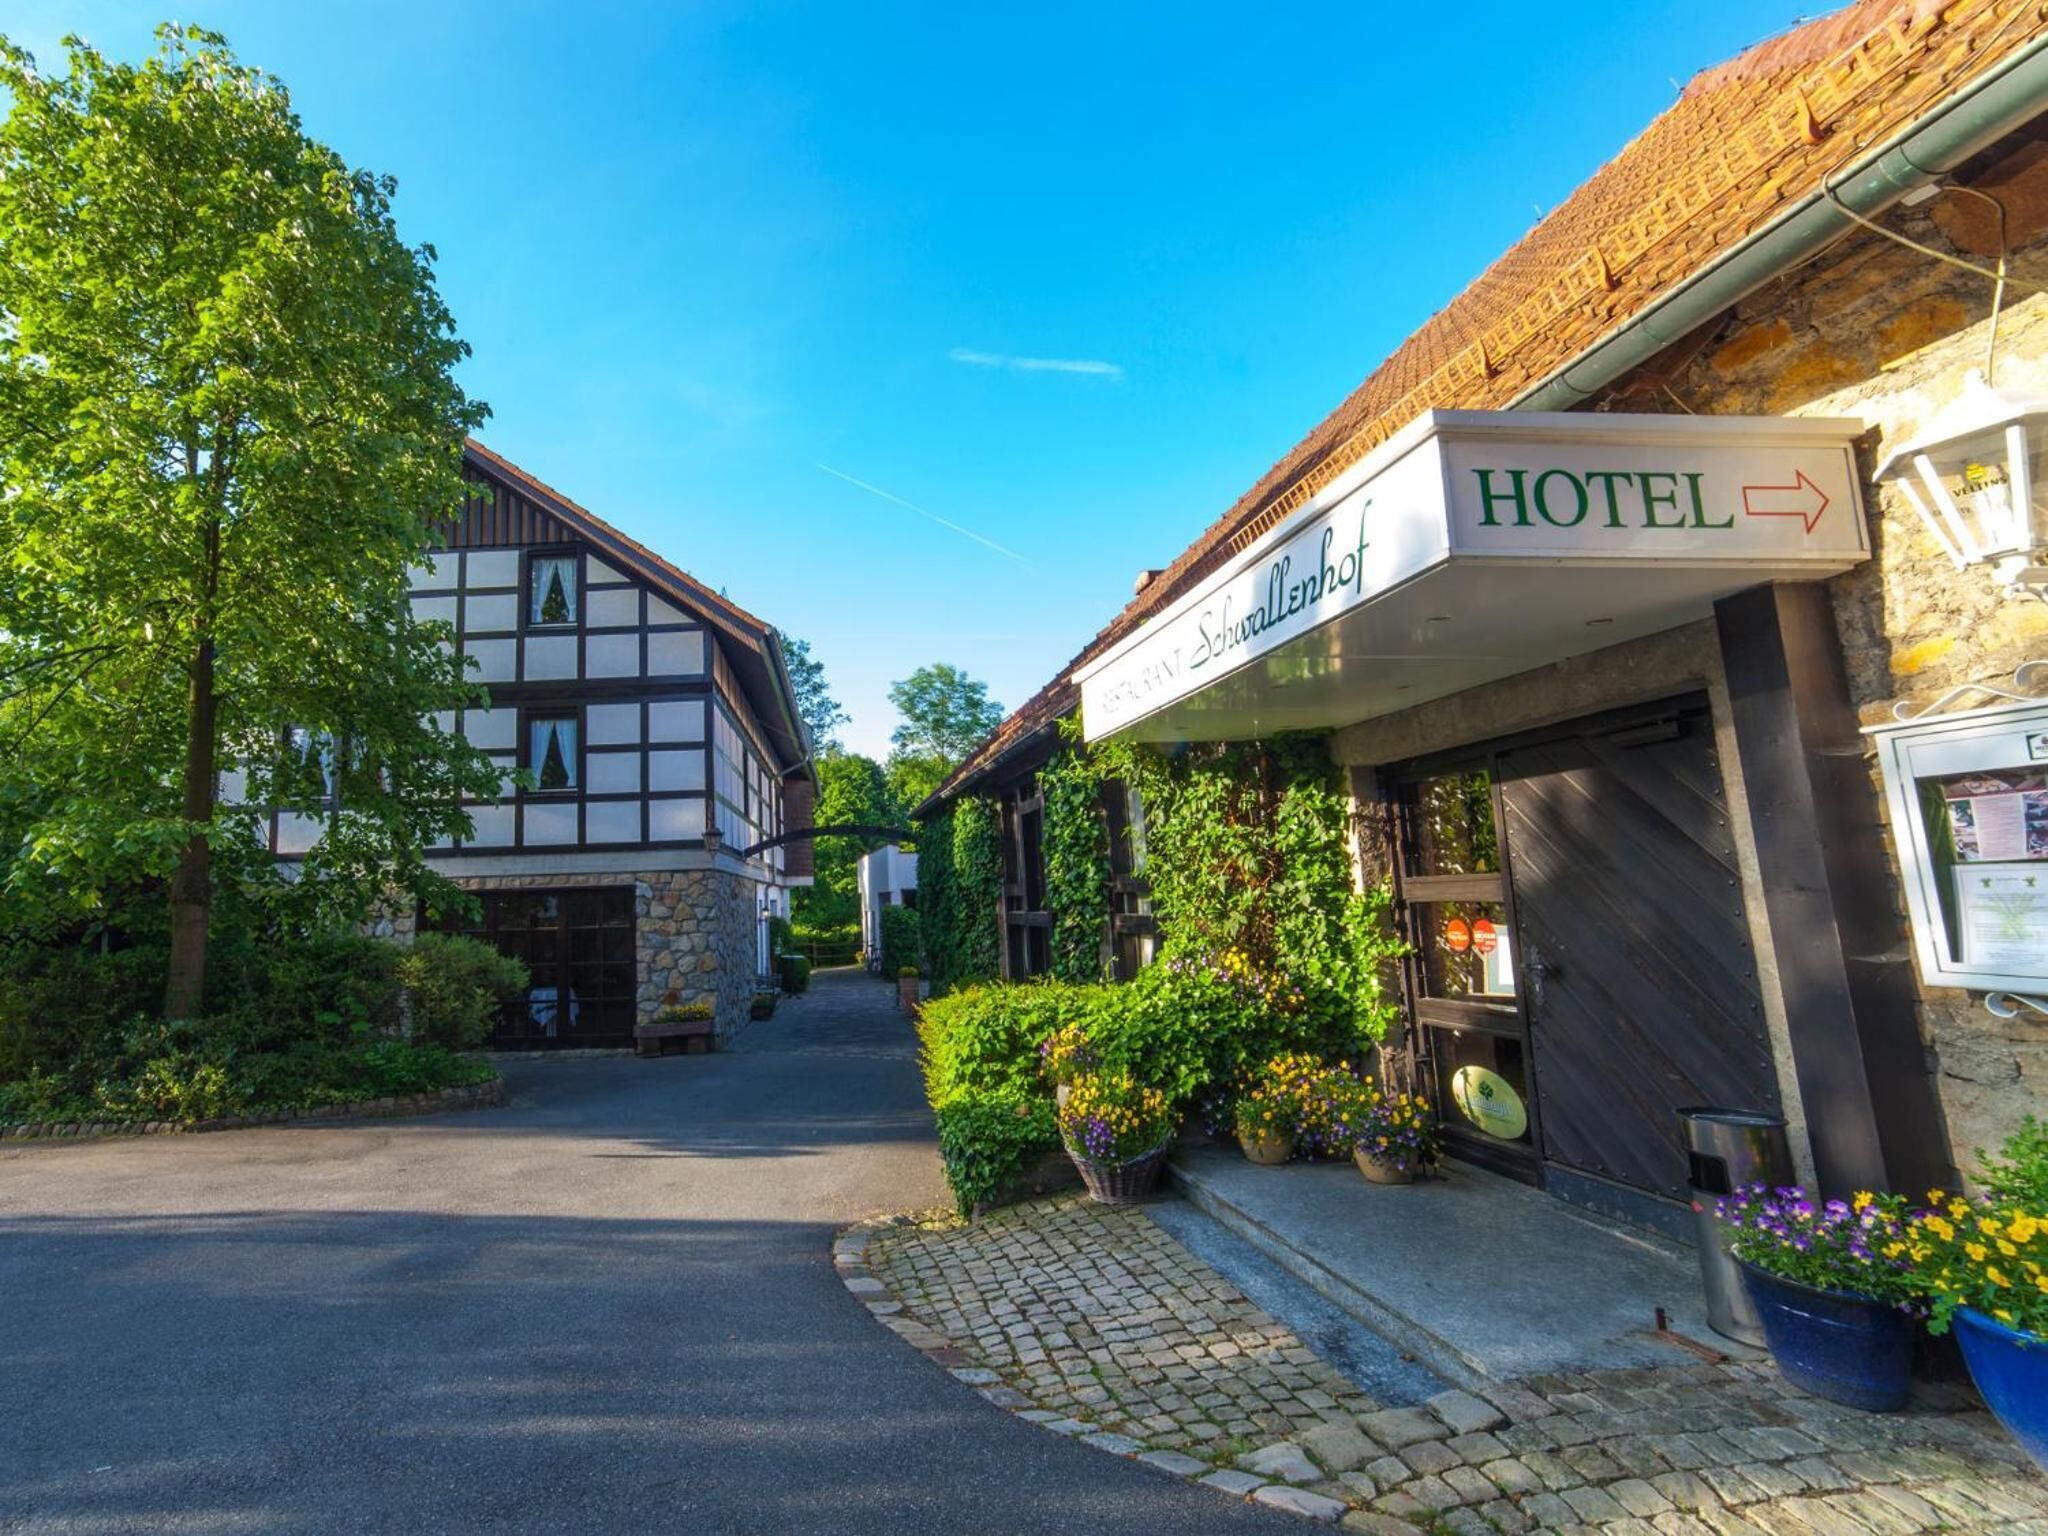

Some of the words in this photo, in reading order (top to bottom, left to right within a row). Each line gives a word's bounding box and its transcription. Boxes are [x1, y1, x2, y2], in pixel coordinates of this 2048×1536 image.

[1472, 468, 1734, 529] HOTEL
[1953, 473, 2009, 497] VELTINS
[1190, 499, 1373, 669] Schwallenhof
